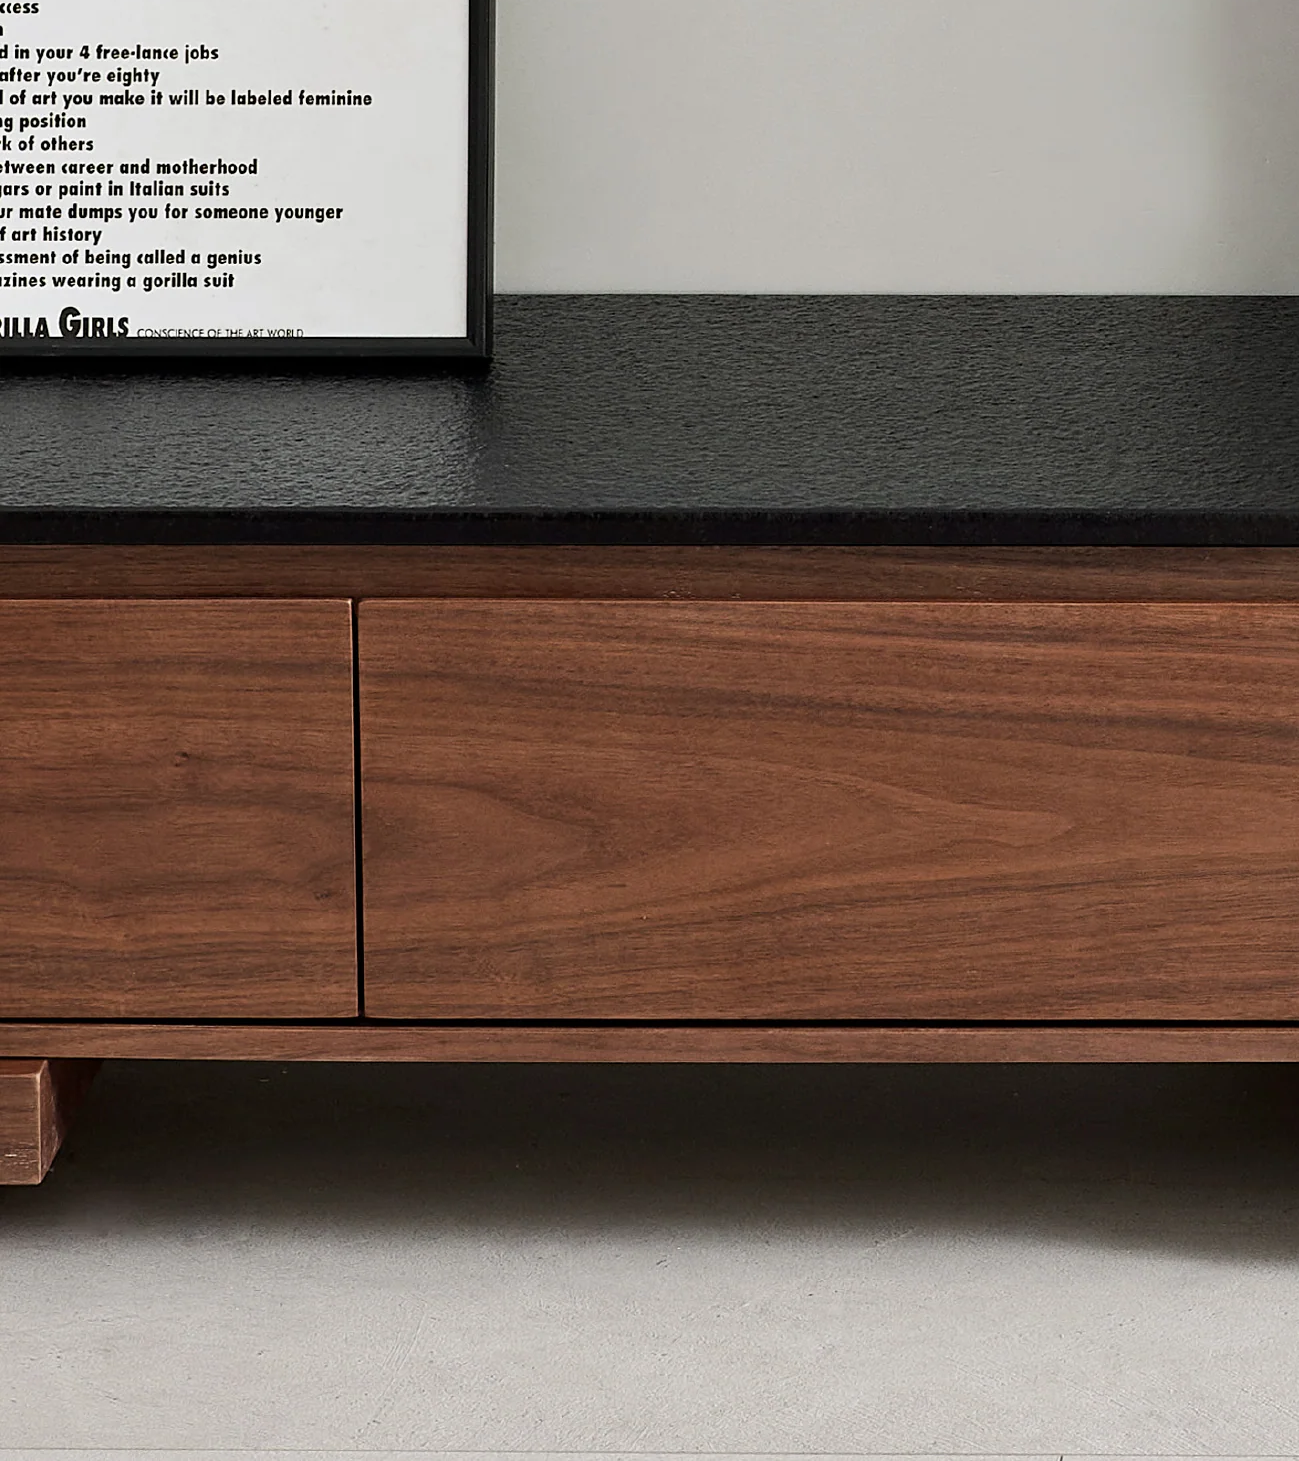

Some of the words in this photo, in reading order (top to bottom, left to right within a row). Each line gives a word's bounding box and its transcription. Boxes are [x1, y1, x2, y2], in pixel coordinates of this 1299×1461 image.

[15, 44, 30, 59] in
[36, 48, 74, 64] your
[79, 45, 90, 59] 4
[96, 44, 179, 60] free-lance
[185, 44, 219, 64] jobs
[0, 66, 41, 82] after
[46, 68, 101, 87] you're
[106, 67, 160, 87] eighty
[10, 89, 27, 105] of
[32, 90, 57, 105] art
[62, 94, 93, 110] you
[99, 89, 145, 106] make
[150, 89, 163, 106] it
[168, 89, 199, 106] will
[205, 89, 226, 106] be
[231, 89, 293, 106] labeled
[298, 89, 373, 106] feminine
[19, 112, 87, 133] position
[0, 135, 12, 151] k
[18, 135, 35, 151] of
[40, 135, 94, 151] others
[61, 163, 114, 175] career
[119, 158, 150, 175] and
[156, 158, 258, 175] motherhood
[0, 184, 30, 198] ars
[35, 184, 53, 196] or
[58, 180, 103, 200] paint
[108, 180, 124, 196] in
[129, 180, 184, 197] Italian
[189, 180, 230, 197] suits
[19, 205, 62, 219] mate
[67, 203, 123, 223] dumps
[128, 207, 158, 223] you
[164, 203, 189, 219] for
[194, 207, 269, 219] someone
[274, 207, 344, 223] younger
[11, 228, 37, 241] art
[42, 226, 103, 246] history
[61, 249, 79, 265] of
[84, 249, 131, 269] being
[136, 249, 186, 265] called
[190, 253, 201, 265] a
[207, 249, 262, 269] genius
[0, 272, 47, 288] zines
[51, 272, 121, 293] wearing
[126, 276, 136, 288] a
[142, 272, 198, 293] gorilla
[203, 272, 235, 288] suit
[0, 316, 51, 338] ILLA
[58, 306, 129, 338] GIRLS
[136, 328, 204, 338] CONSCIENCE
[207, 328, 221, 338] OF
[225, 328, 243, 338] THE
[246, 328, 264, 338] ART
[267, 328, 304, 338] WORLD
